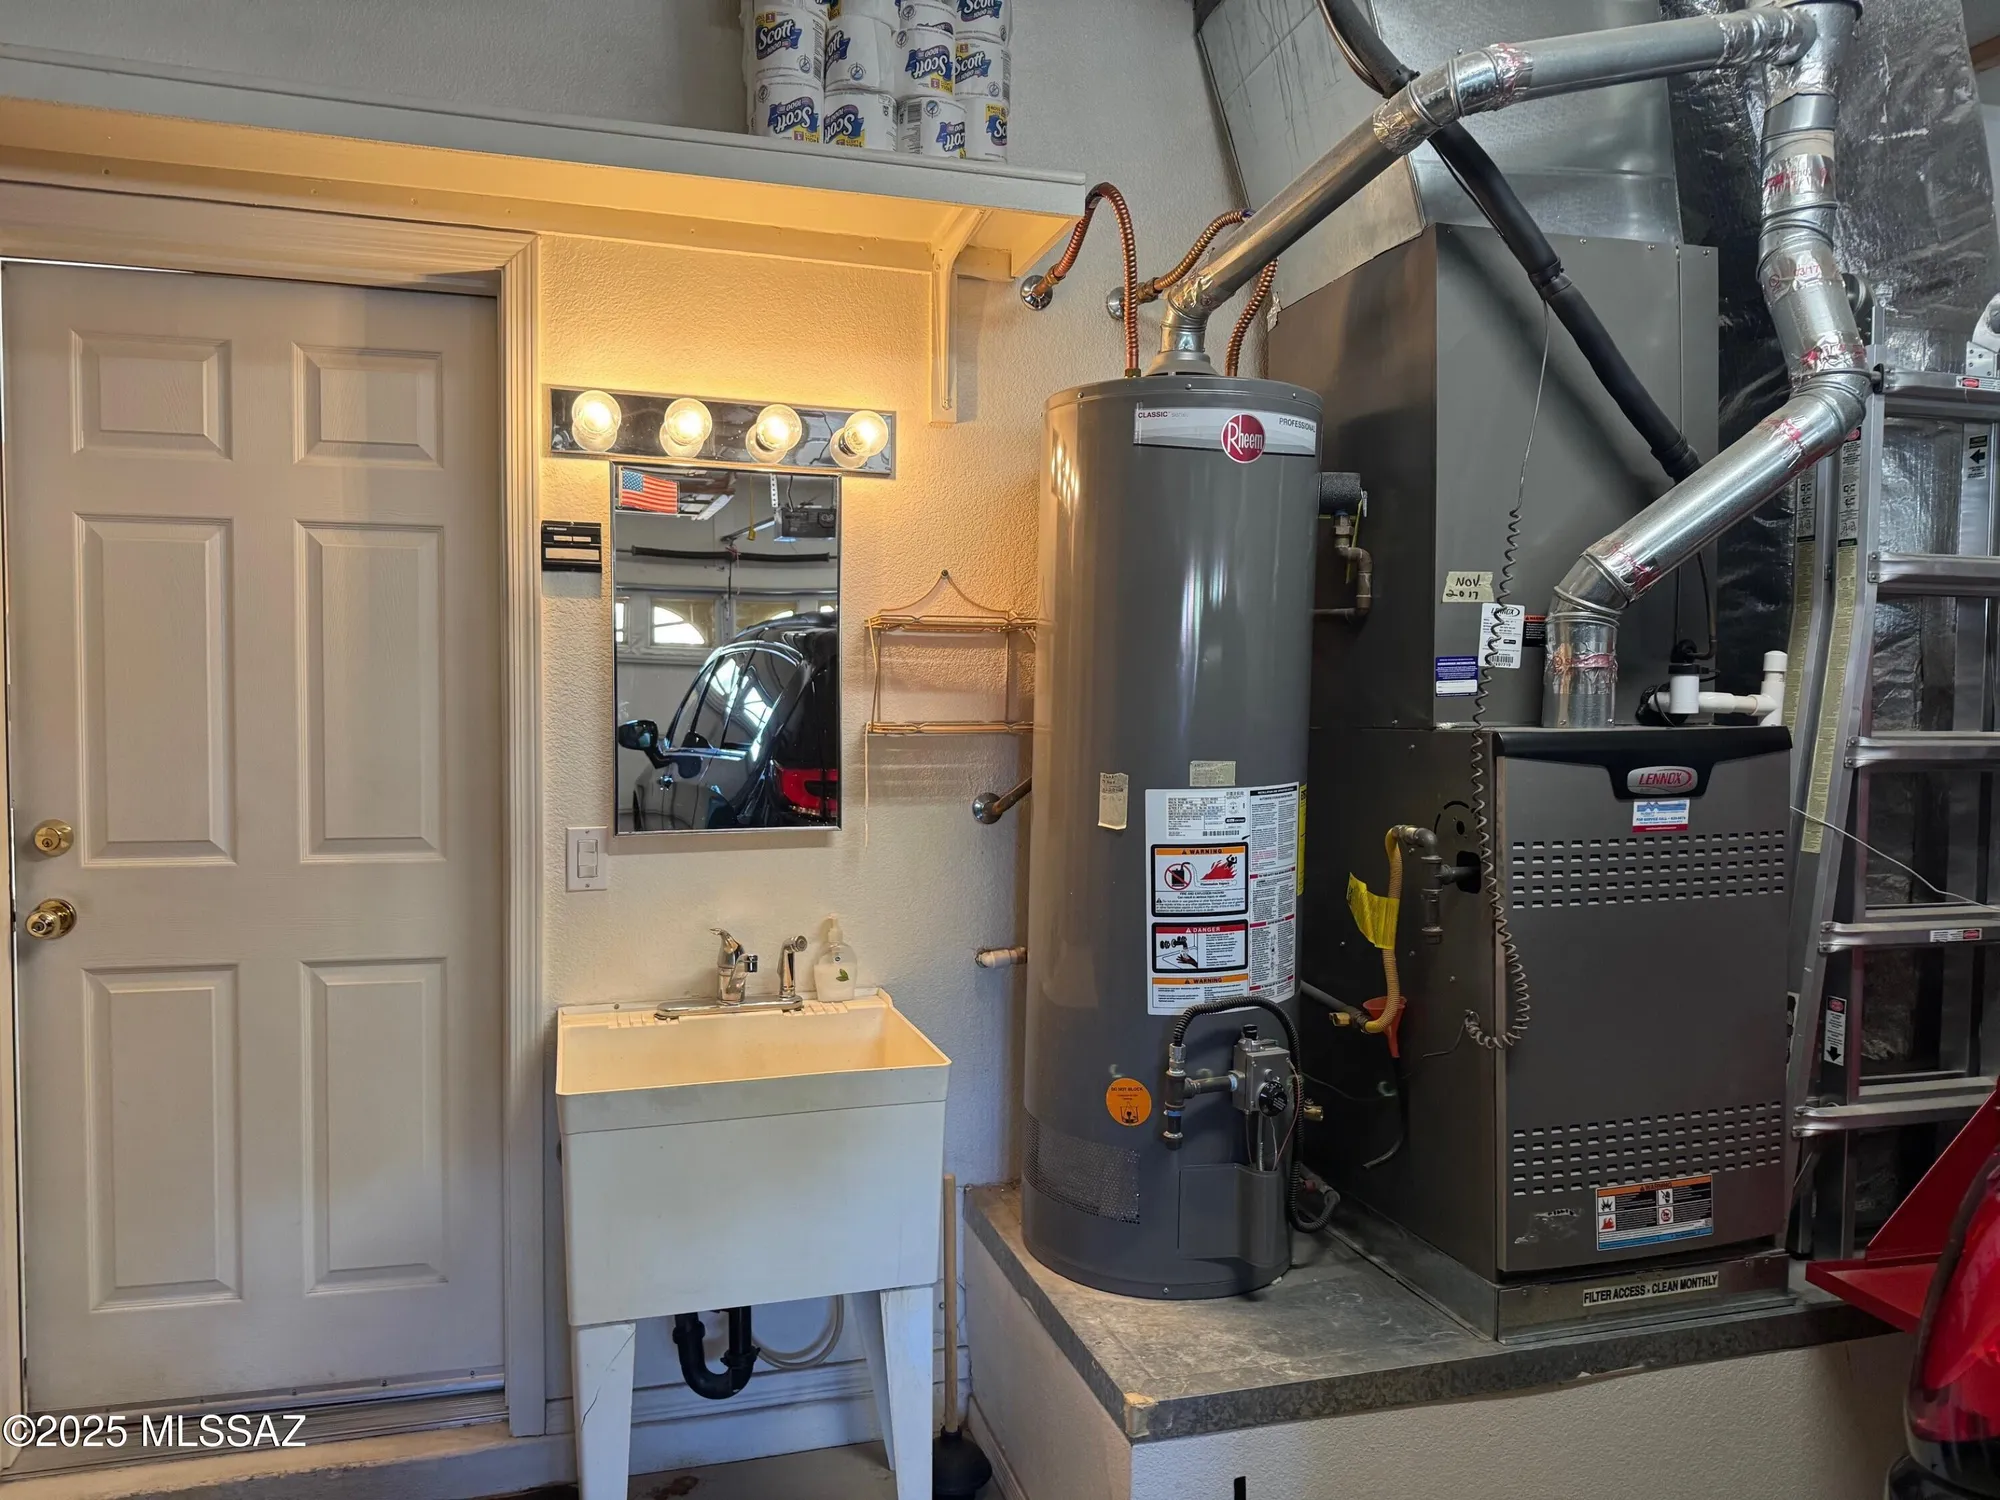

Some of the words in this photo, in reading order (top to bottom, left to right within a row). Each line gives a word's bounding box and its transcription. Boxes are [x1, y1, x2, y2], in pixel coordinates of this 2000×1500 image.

[758, 20, 794, 50] Scott
[913, 55, 948, 79] Scott
[775, 106, 812, 133] Scott
[1138, 411, 1168, 419] CLASSIC
[1279, 417, 1316, 433] PROFESSIONAL
[1228, 414, 1263, 455] Rheem
[1638, 772, 1682, 785] LENNOX
[1584, 1289, 1611, 1304] FILTER
[1612, 1284, 1646, 1300] ACCESS
[1651, 1280, 1679, 1294] CLEAN
[1680, 1274, 1718, 1290] MONTHLY
